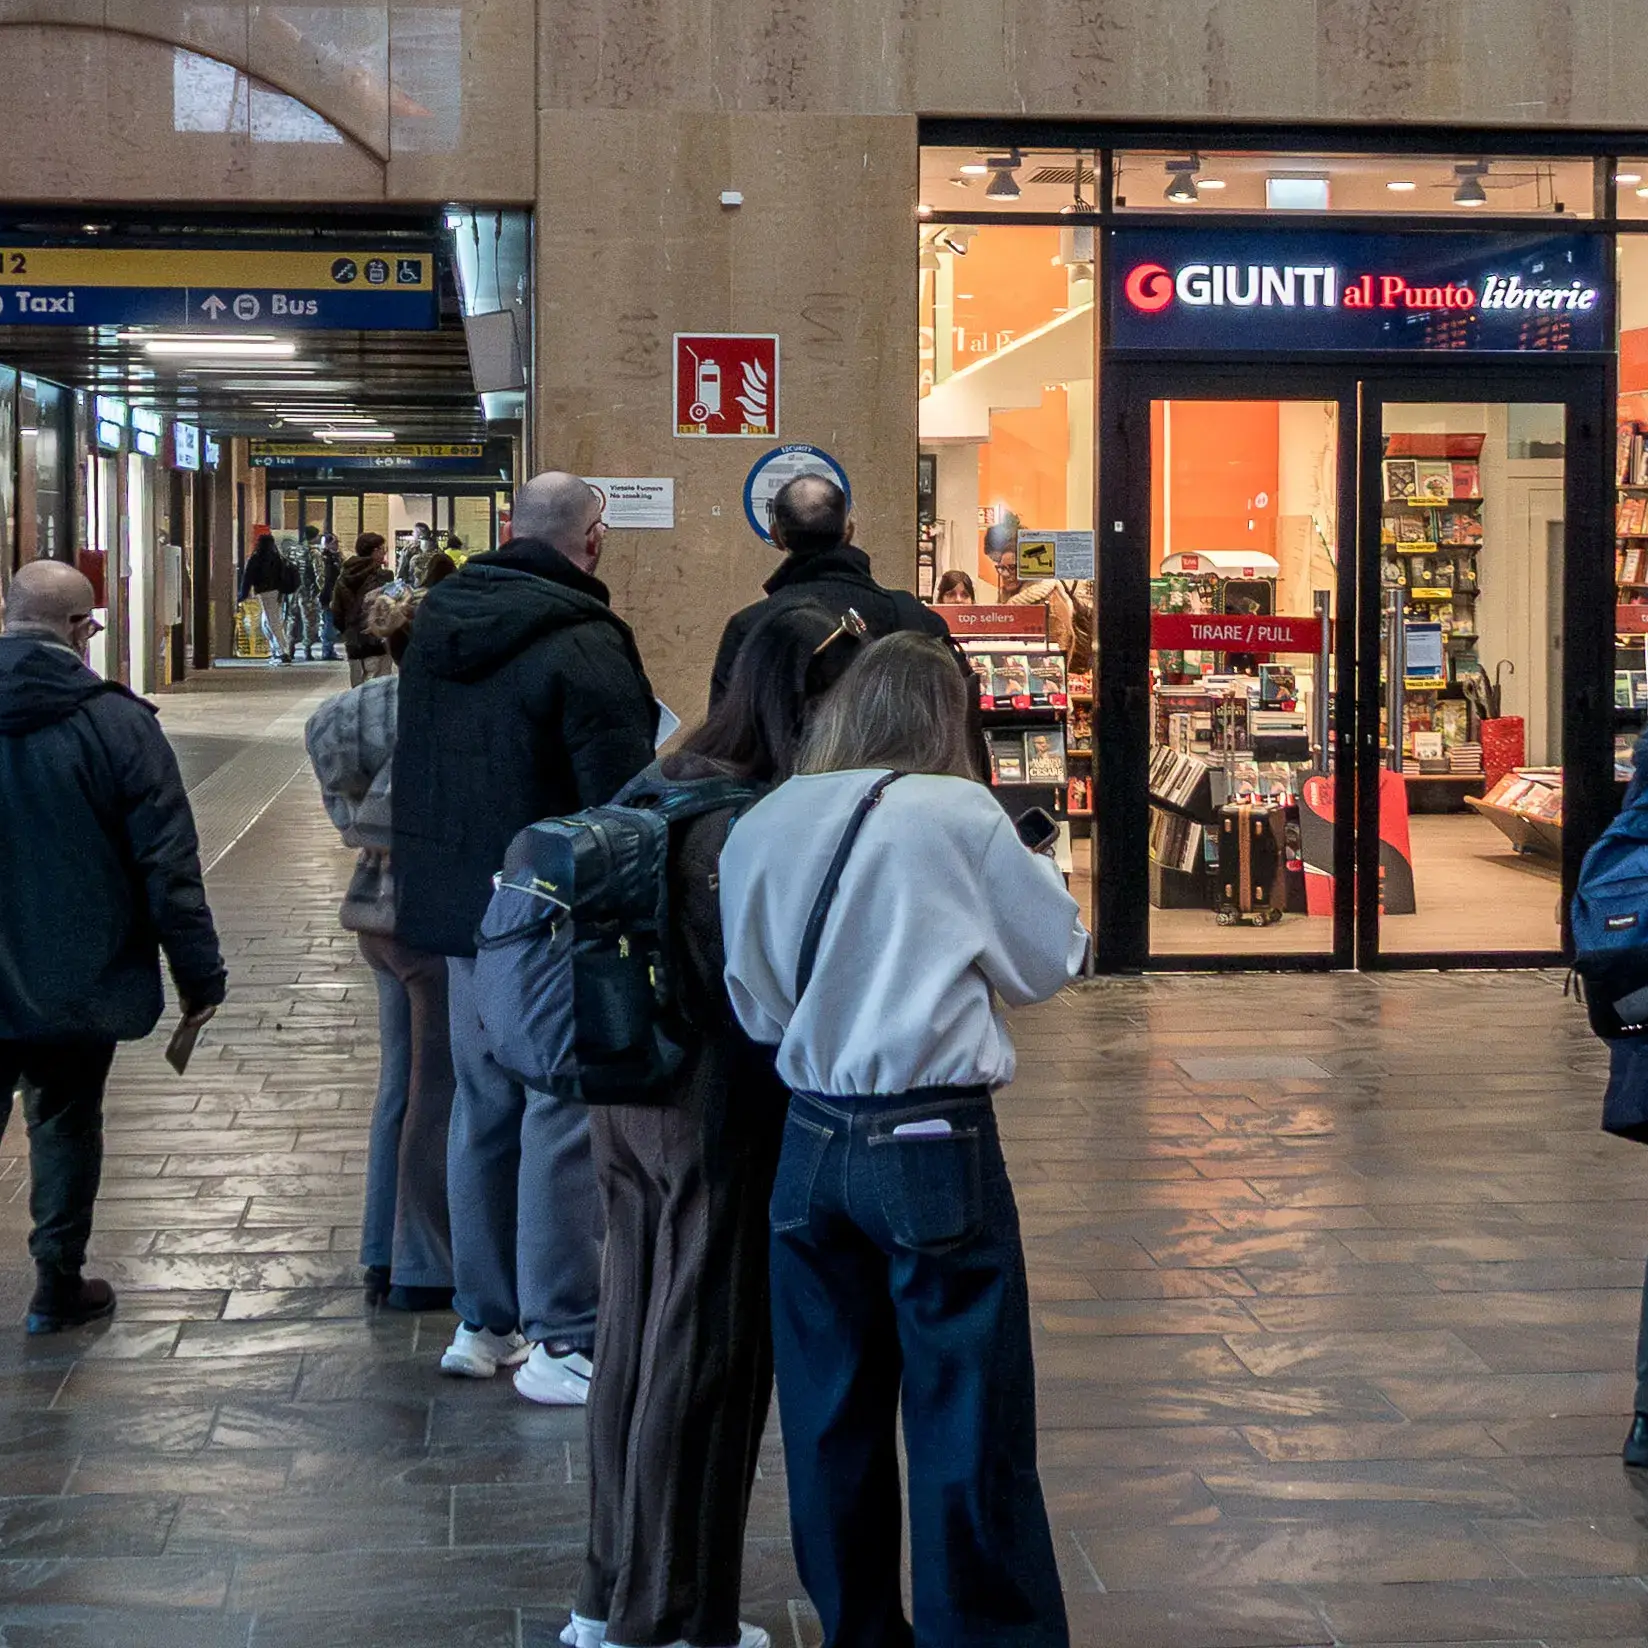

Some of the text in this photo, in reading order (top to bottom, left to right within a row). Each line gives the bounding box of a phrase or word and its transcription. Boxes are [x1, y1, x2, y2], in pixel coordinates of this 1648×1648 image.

[1174, 263, 1597, 310] GIUNTI al Punto librerie
[15, 291, 75, 314] Taxi
[271, 294, 319, 317] Bus
[623, 492, 652, 501] smoking
[957, 612, 1015, 623] top sellers
[1190, 624, 1243, 641] TIRARE
[1257, 627, 1294, 642] PULL
